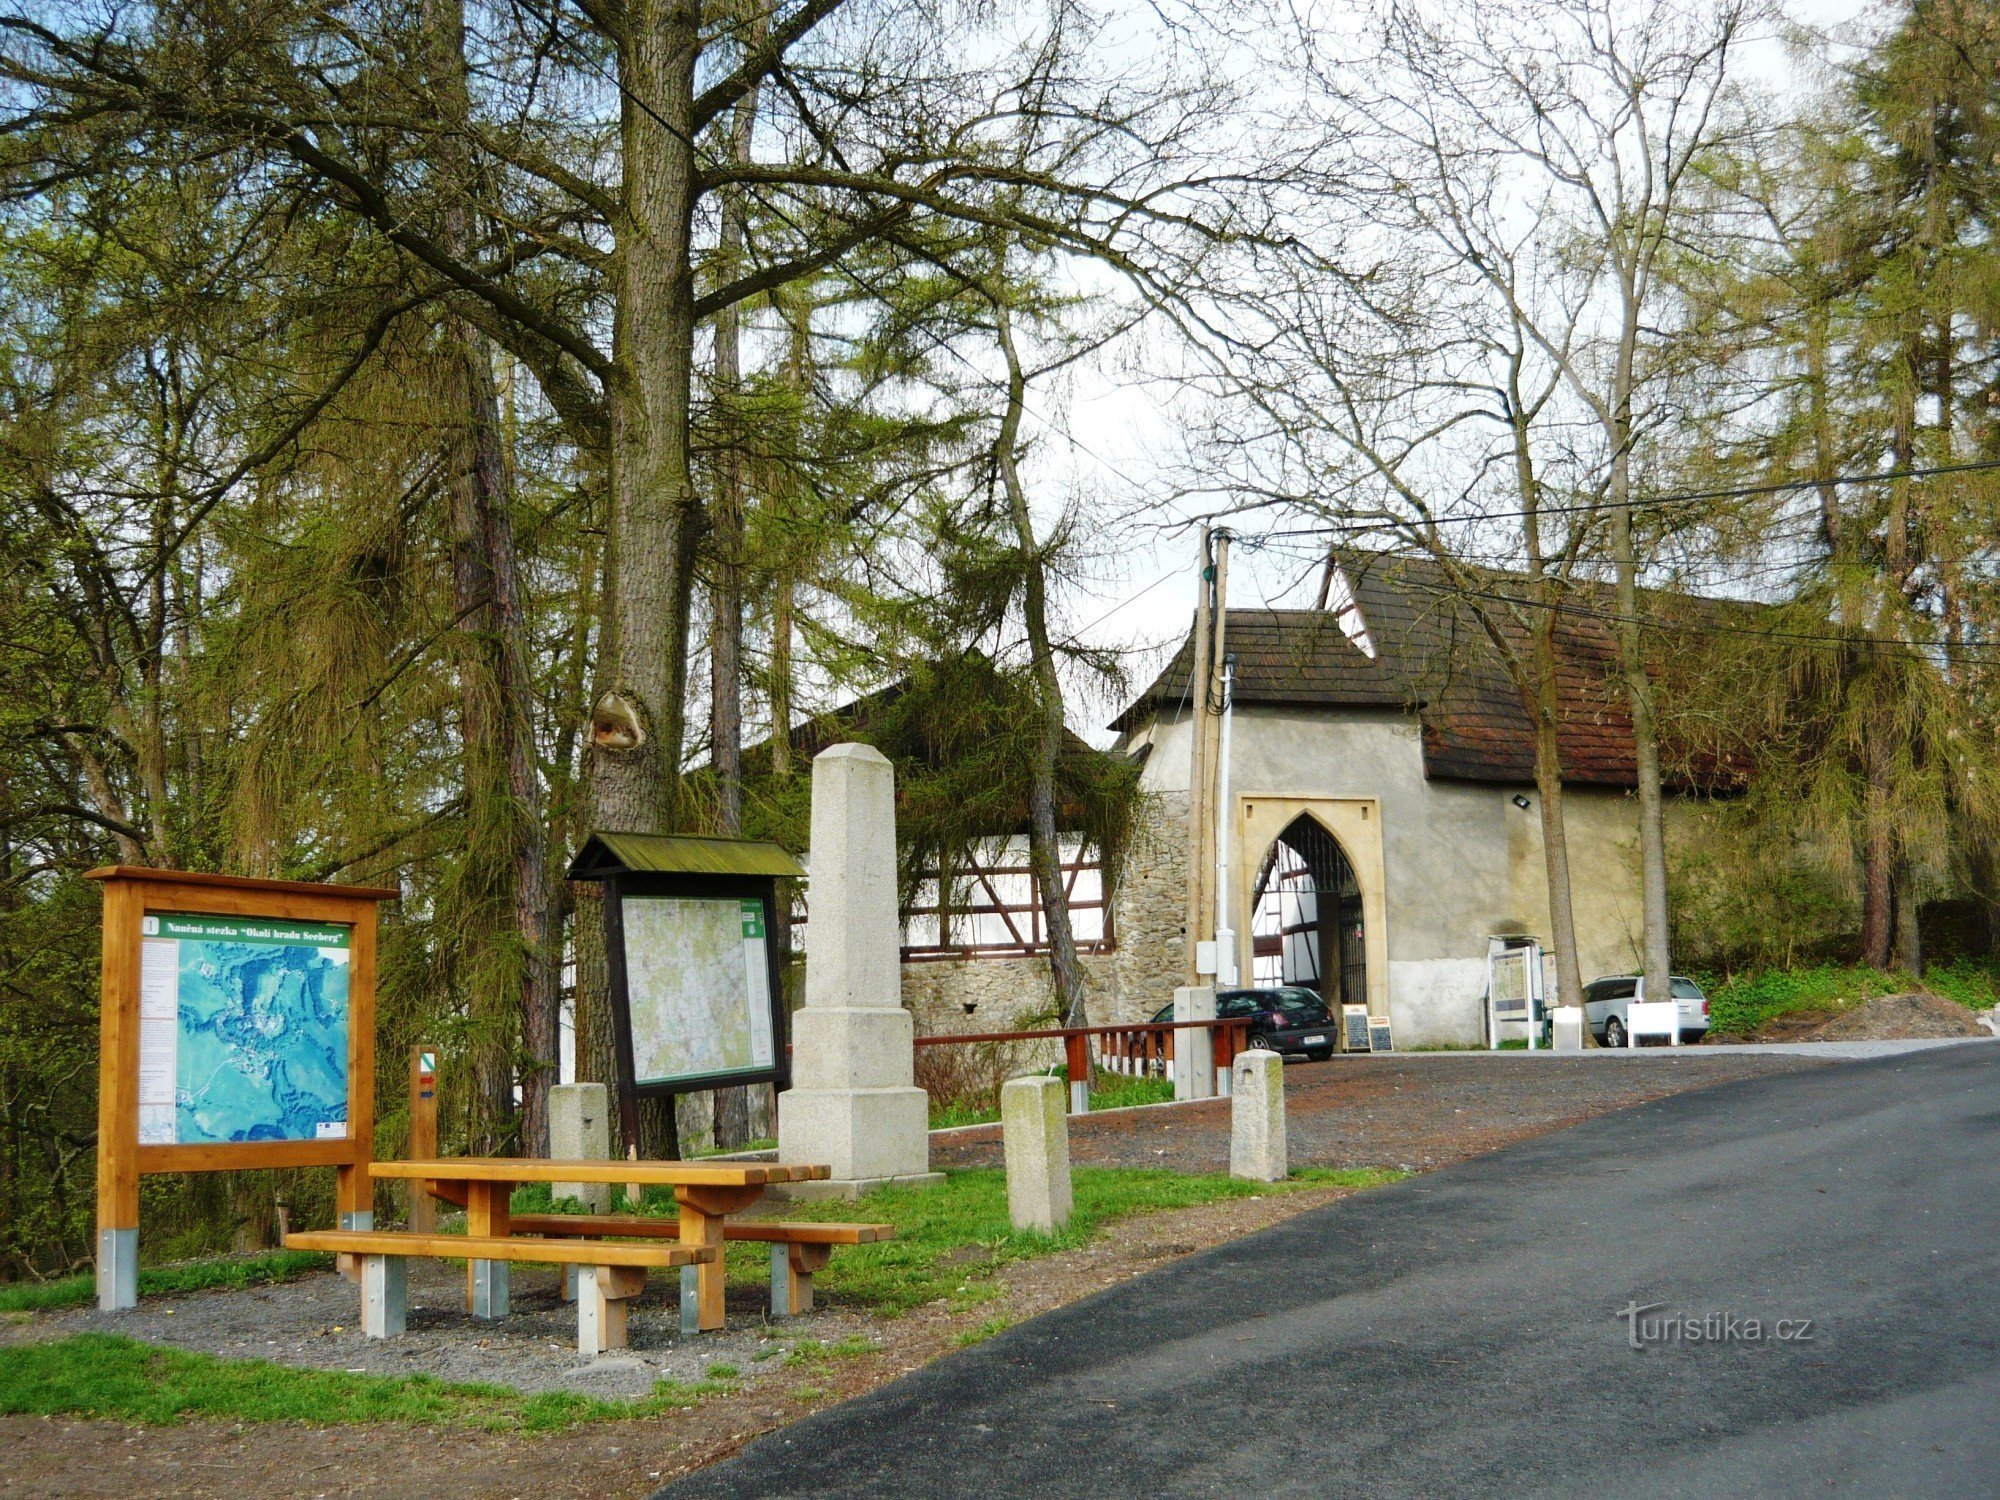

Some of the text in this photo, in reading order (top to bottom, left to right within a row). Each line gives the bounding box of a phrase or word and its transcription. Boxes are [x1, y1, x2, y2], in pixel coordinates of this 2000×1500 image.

[167, 922, 204, 934] Naučná
[206, 926, 238, 936] stezka
[273, 929, 301, 939] hradu
